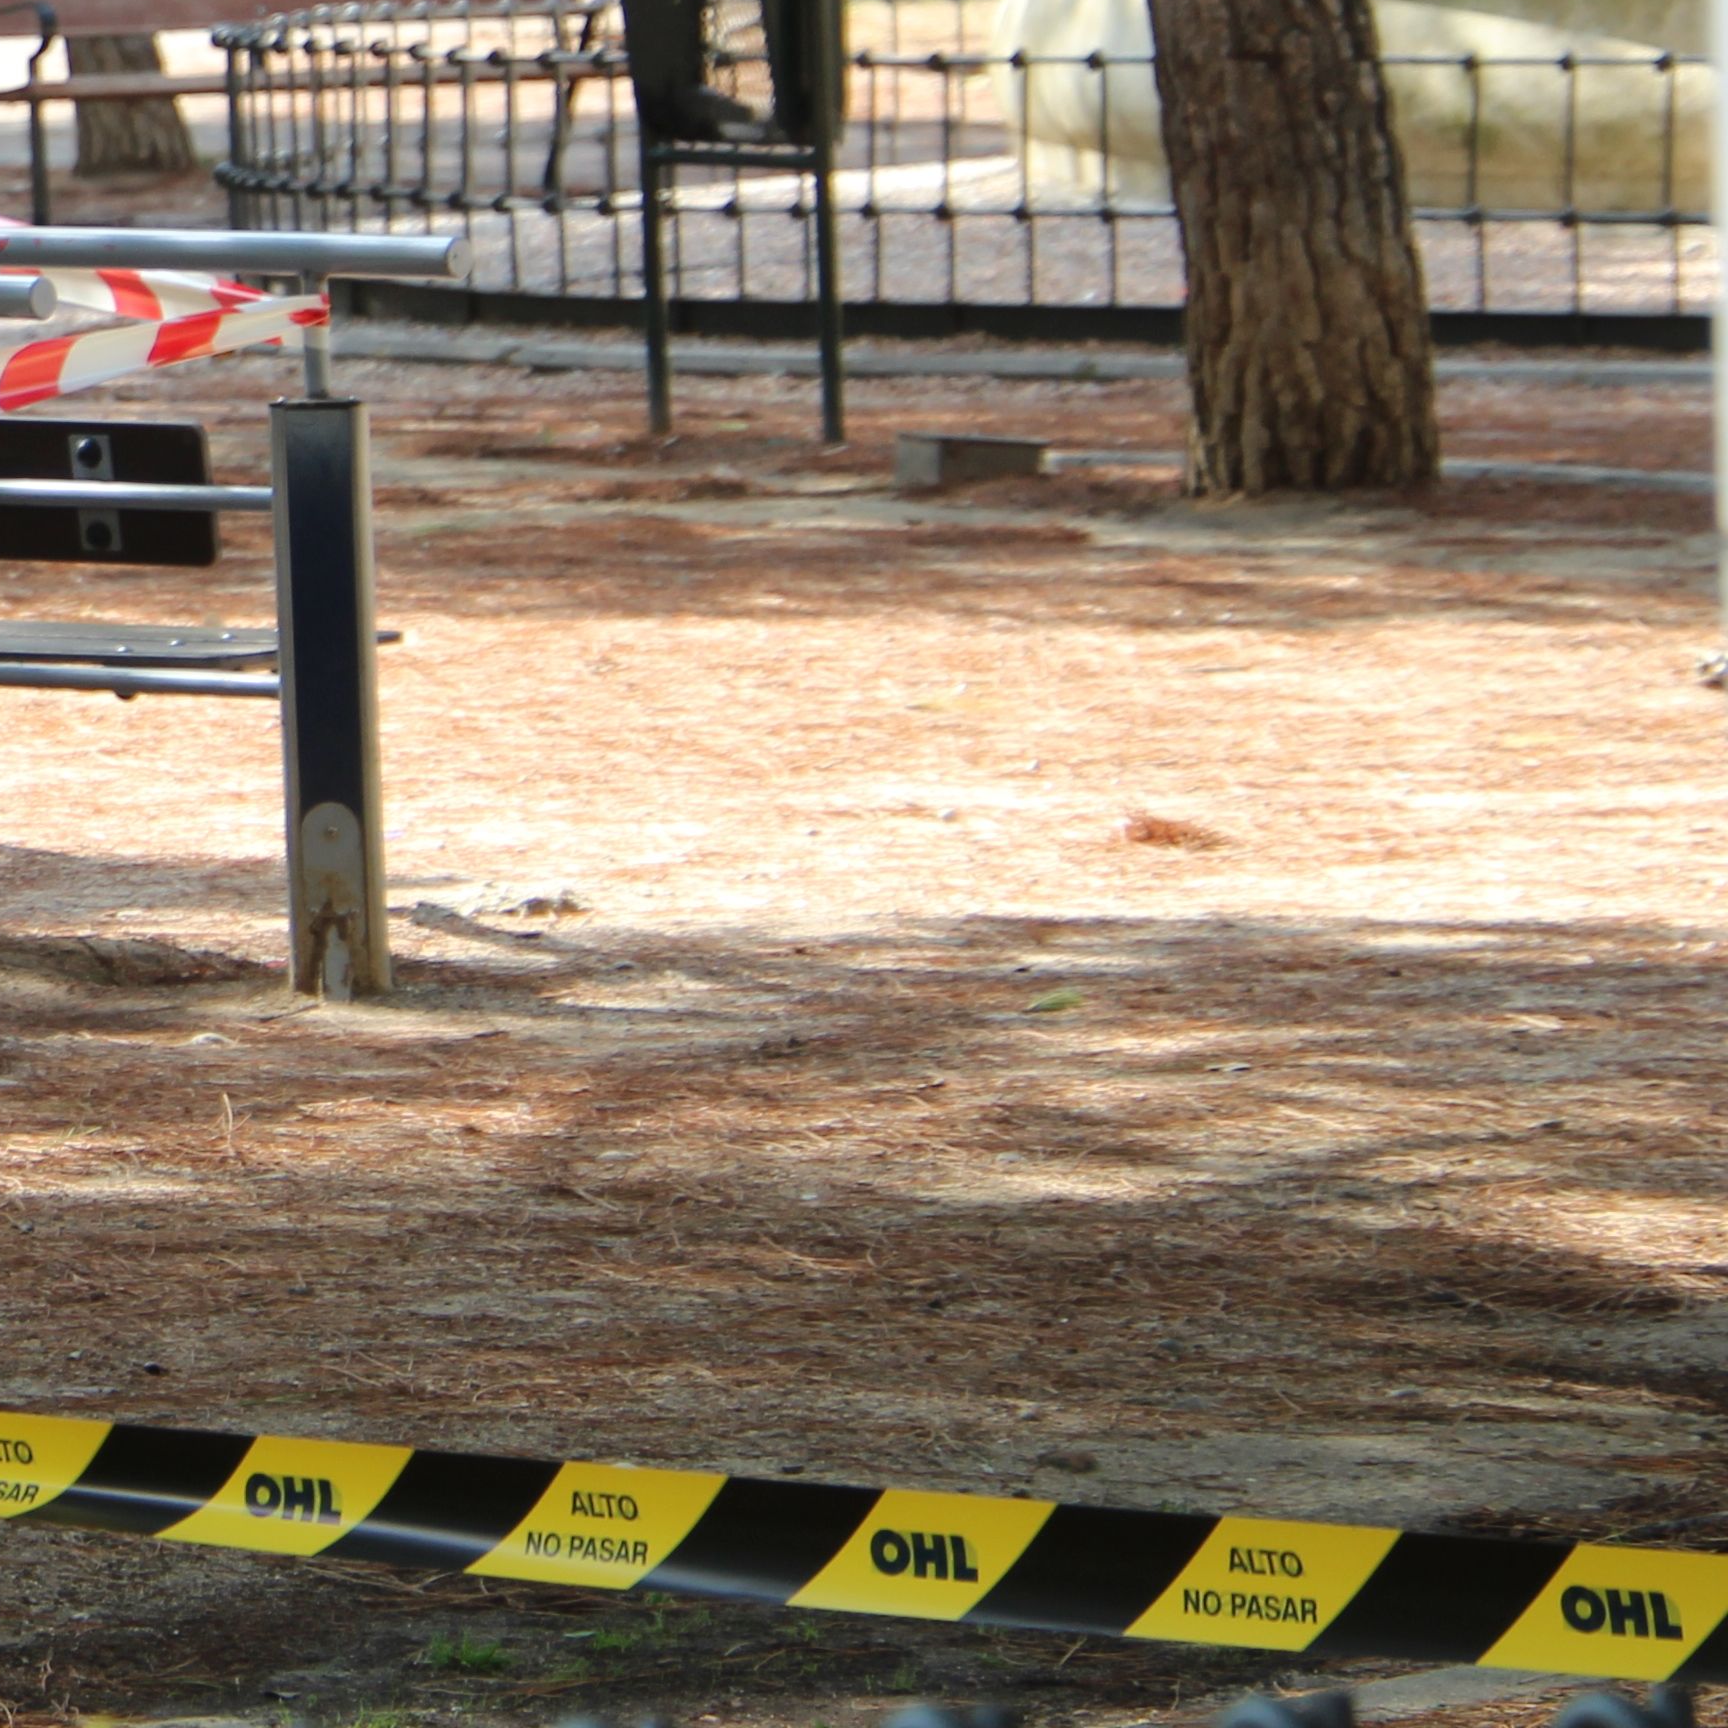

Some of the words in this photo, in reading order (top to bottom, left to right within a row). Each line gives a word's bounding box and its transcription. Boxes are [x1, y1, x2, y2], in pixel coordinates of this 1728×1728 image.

[245, 1472, 342, 1526] OHL
[571, 1491, 639, 1521] ALTO
[525, 1532, 561, 1558] NO
[569, 1536, 648, 1566] PASAR
[870, 1529, 979, 1583] OHL
[1228, 1547, 1304, 1578] ALTO
[1183, 1589, 1222, 1616] NO
[1230, 1593, 1318, 1625] PASAR
[1561, 1585, 1684, 1641] OHL
